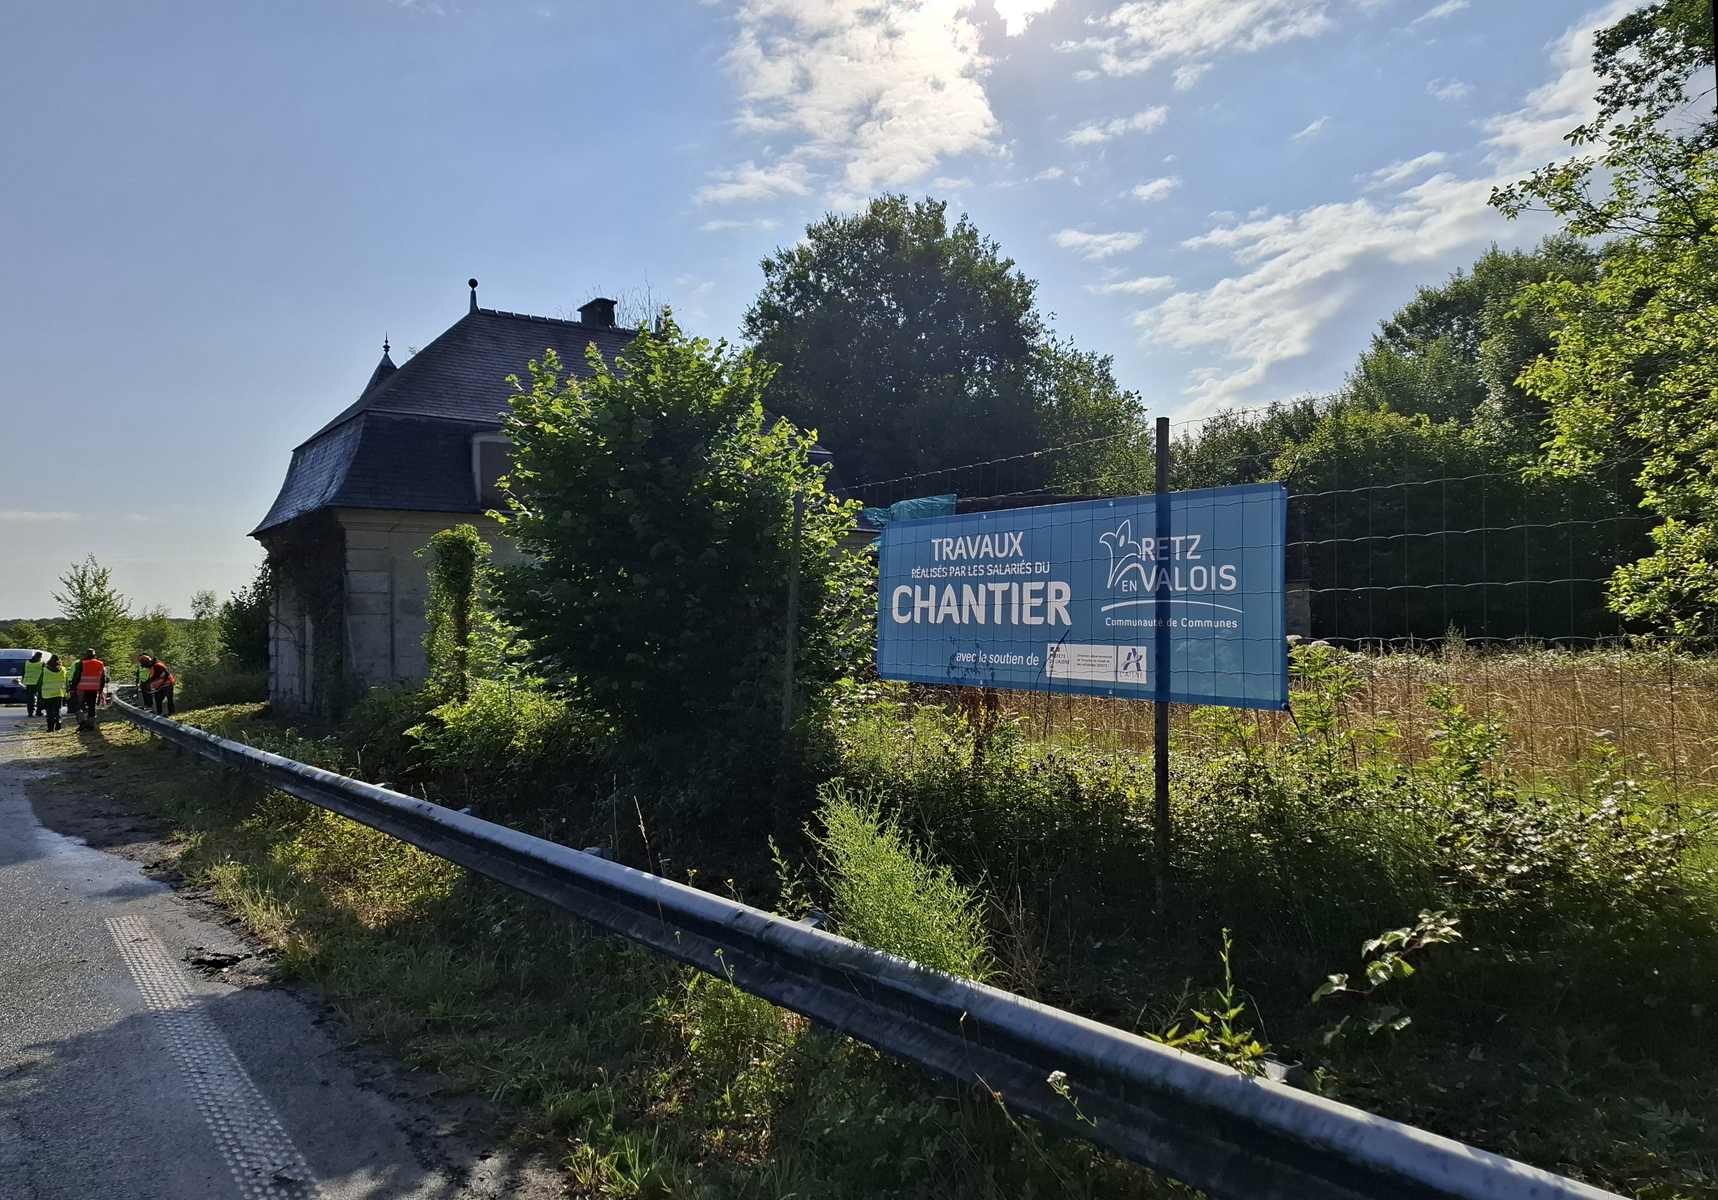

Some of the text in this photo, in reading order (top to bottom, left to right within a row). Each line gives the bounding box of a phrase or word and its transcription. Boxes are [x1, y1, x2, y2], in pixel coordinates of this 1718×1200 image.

[932, 531, 1024, 561] TRAVAUX
[1141, 534, 1202, 561] RETZ
[912, 560, 1050, 579] RÉALISÉS PAR LES SALARIÉS DU
[1118, 562, 1237, 593] EN VALOIS
[892, 581, 1072, 626] CHANTIER
[1166, 617, 1177, 627] de
[1181, 617, 1238, 628] Communes
[956, 650, 1040, 666] avec la soutien de
